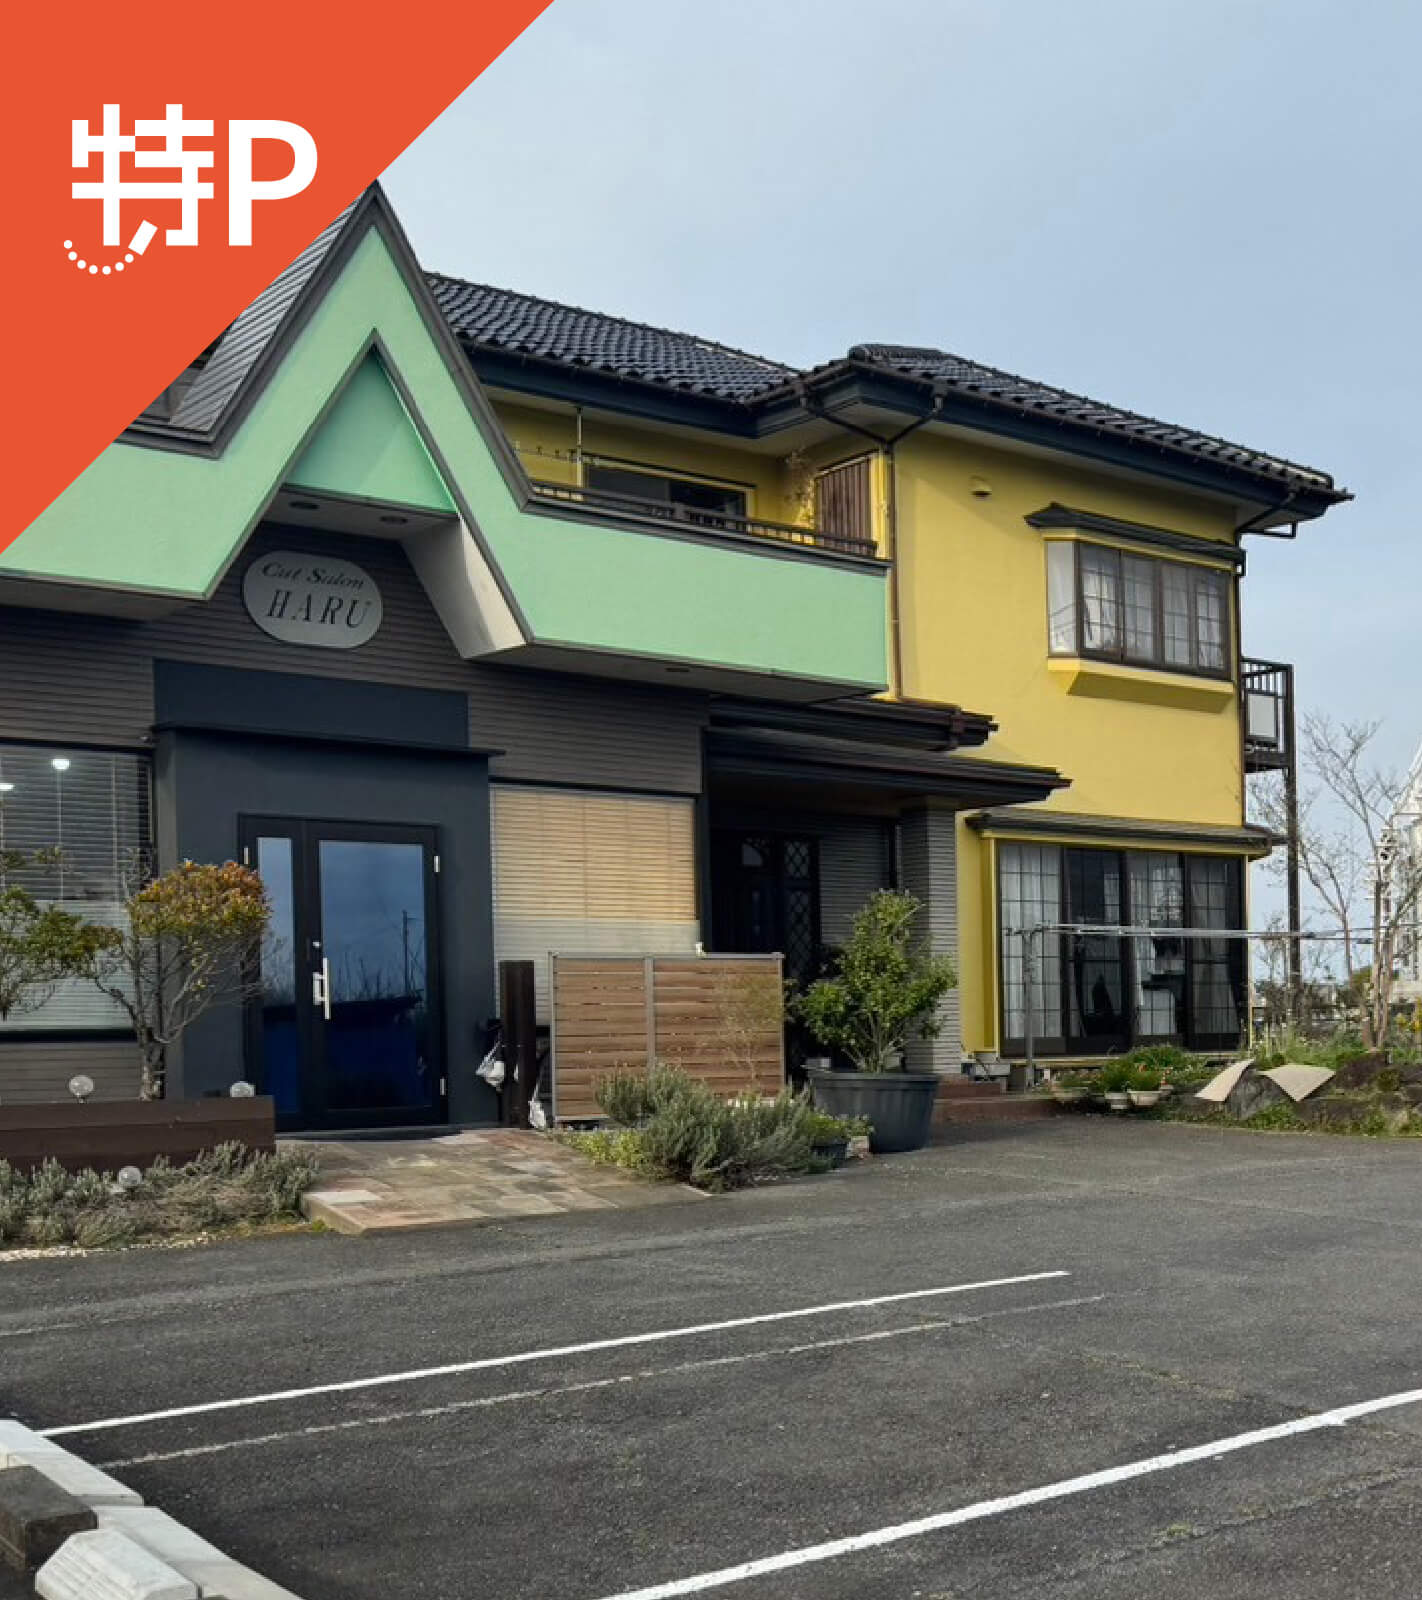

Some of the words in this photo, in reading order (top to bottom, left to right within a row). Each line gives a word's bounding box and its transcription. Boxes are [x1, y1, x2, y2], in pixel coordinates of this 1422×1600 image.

[262, 562, 303, 581] Cut
[306, 567, 364, 590] Salon
[266, 589, 372, 629] HARU
